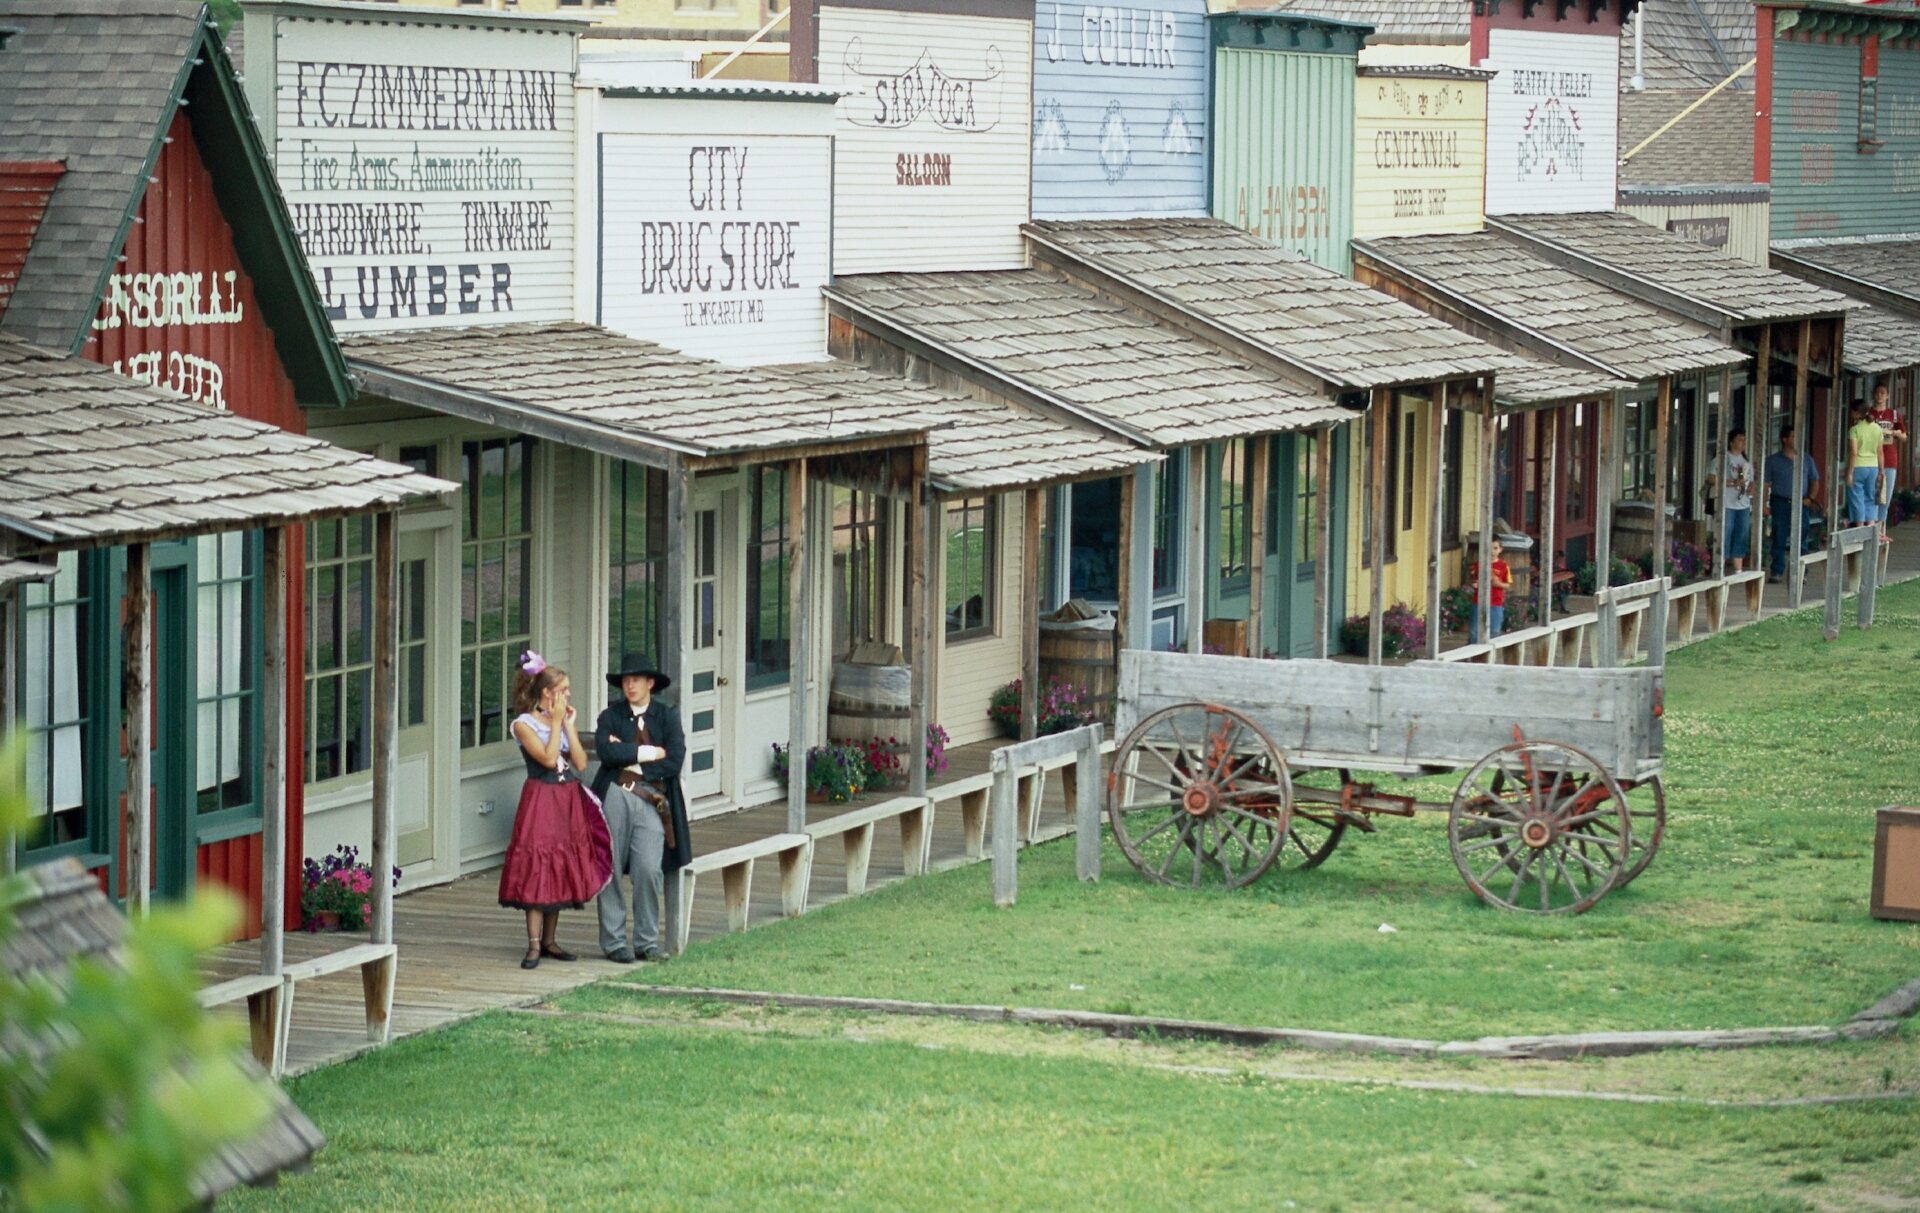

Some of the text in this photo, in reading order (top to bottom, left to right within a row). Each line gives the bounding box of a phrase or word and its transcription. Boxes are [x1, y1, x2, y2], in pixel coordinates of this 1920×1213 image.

[1081, 6, 1176, 69] COLLAR
[301, 139, 338, 191] Fire
[896, 153, 951, 186] SALOON
[1375, 130, 1461, 168] CENTENNIAL
[1517, 110, 1585, 182] RESTAURANT
[689, 147, 748, 211] CITY
[1393, 188, 1446, 217] BARBER SHOP
[462, 201, 552, 251] TINWARE
[641, 222, 800, 294] DRUG STORE
[324, 263, 513, 319] LUMBER
